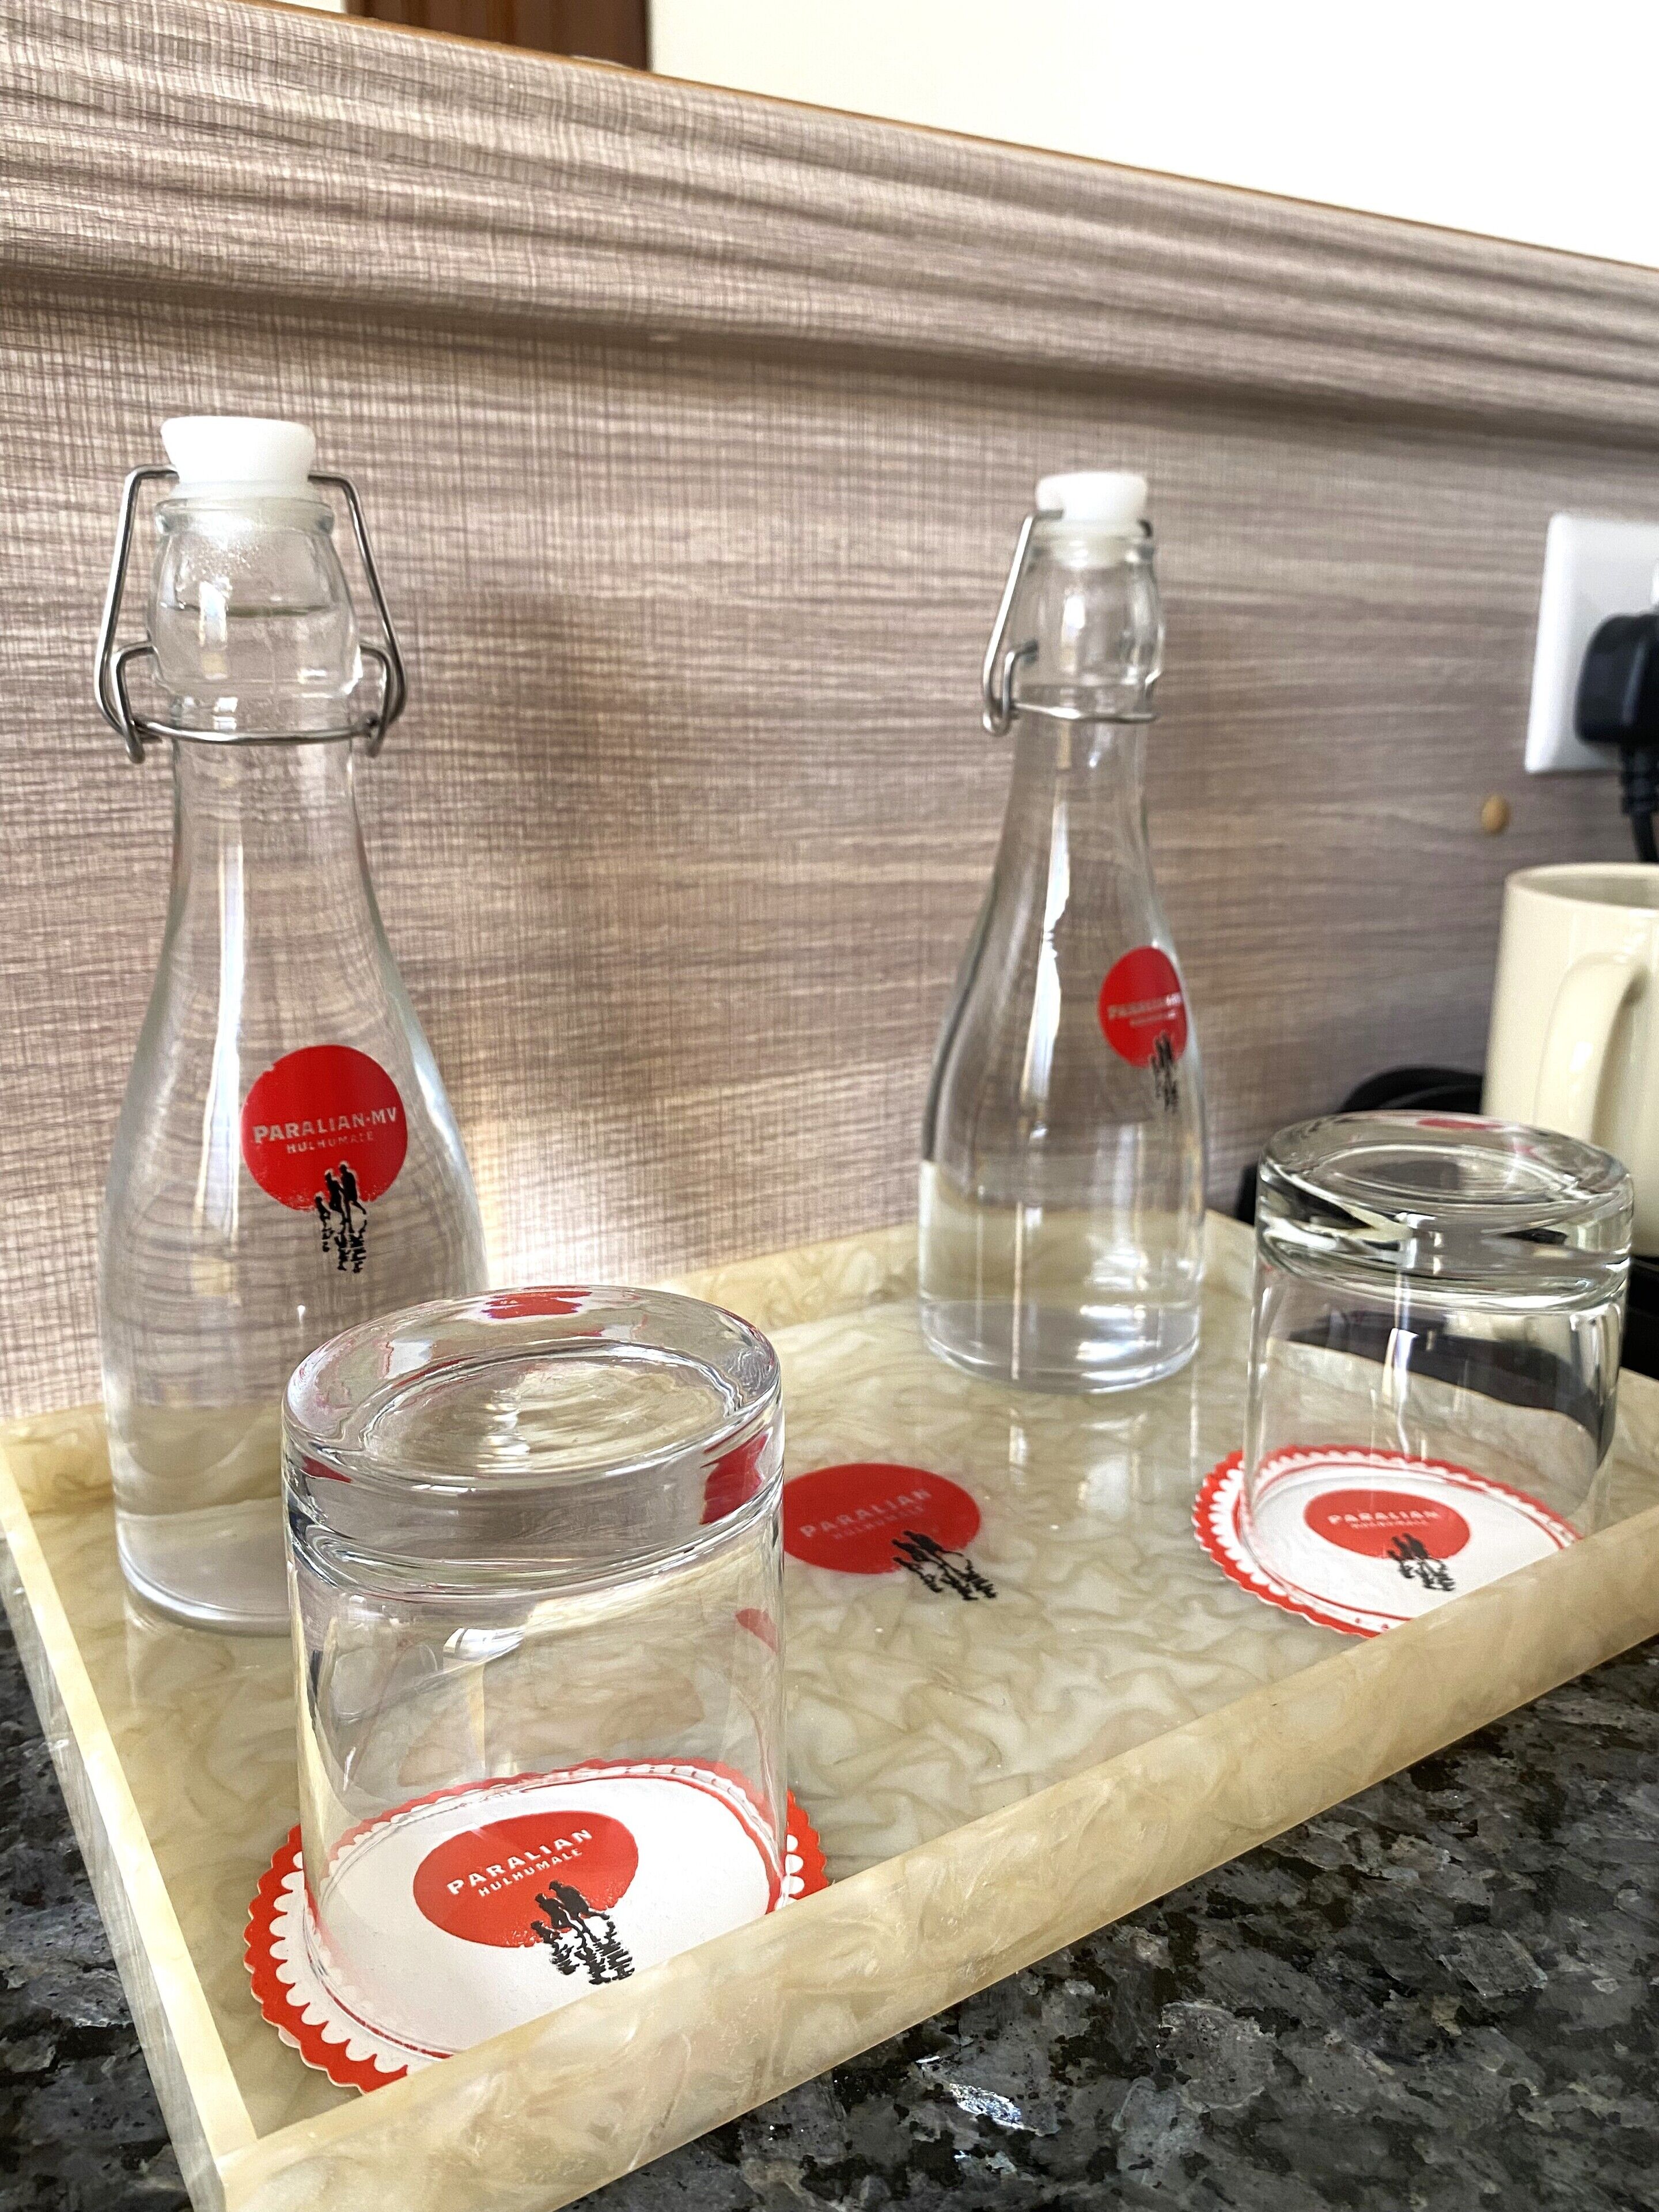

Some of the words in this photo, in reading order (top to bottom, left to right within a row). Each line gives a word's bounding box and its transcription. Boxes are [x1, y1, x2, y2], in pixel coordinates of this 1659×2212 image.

[800, 1488, 931, 1538] PARALIAN
[446, 1829, 593, 1895] PARALIAN
[478, 1847, 583, 1897] HULHUMALE
